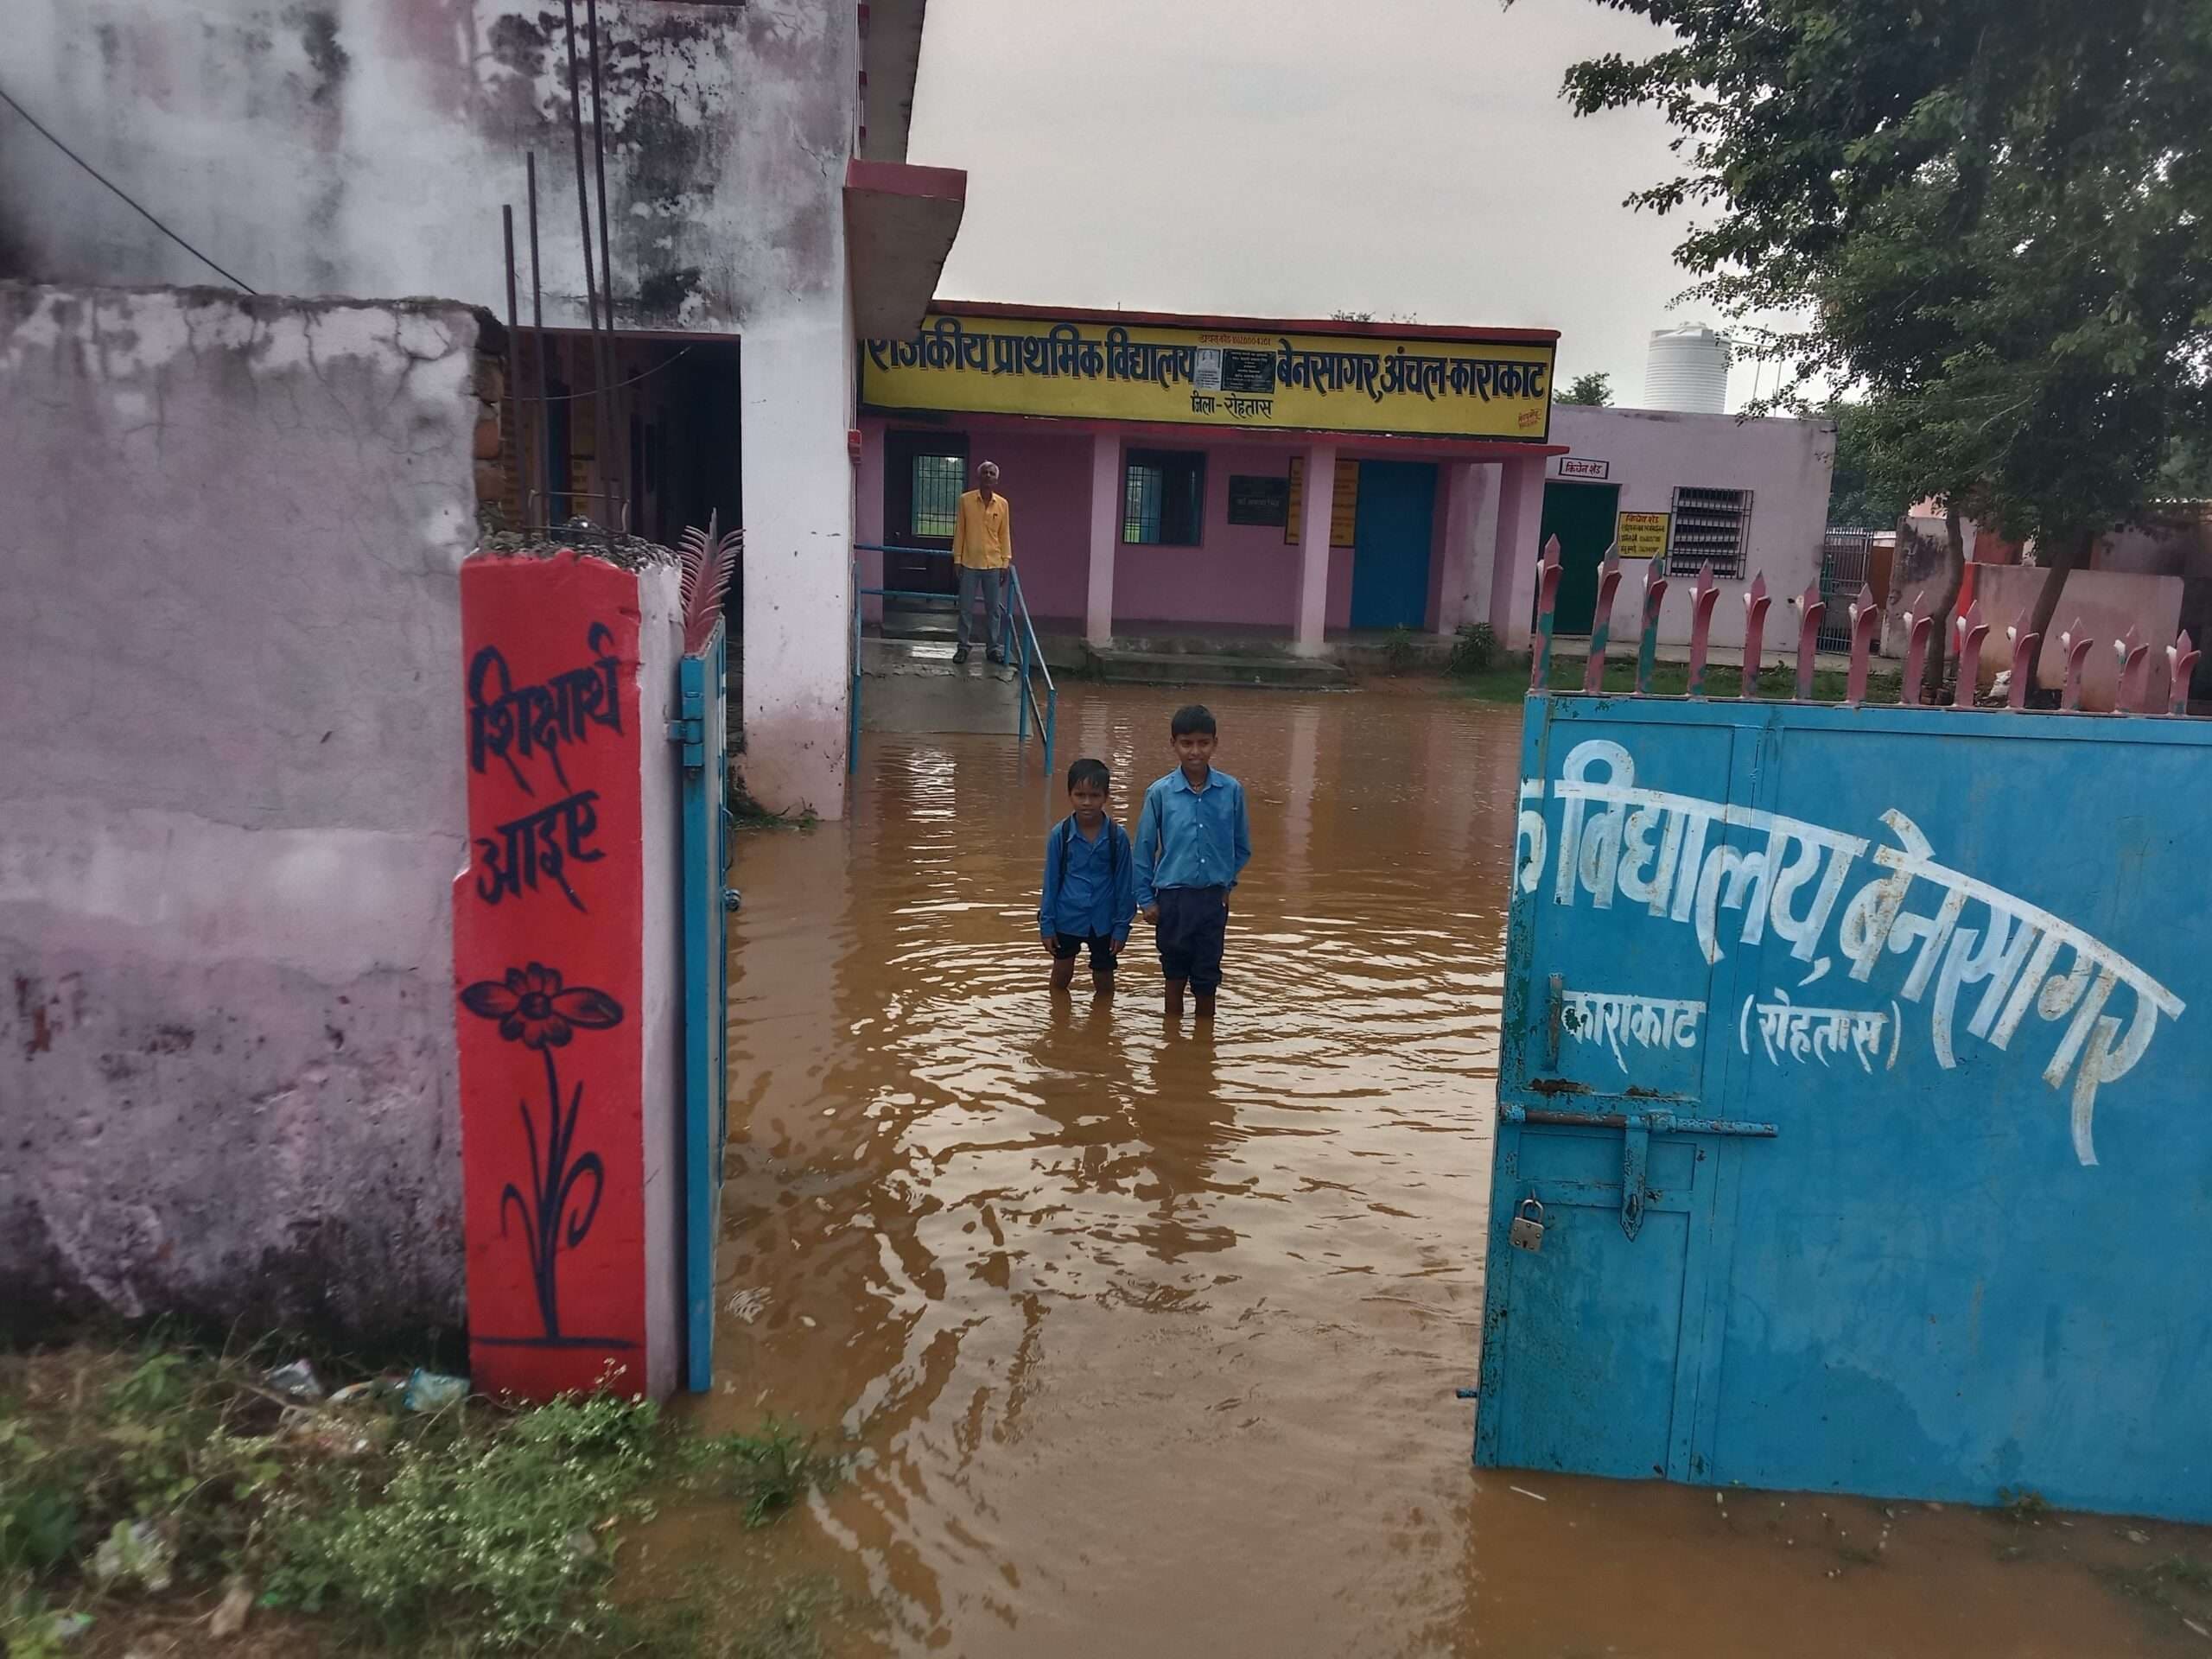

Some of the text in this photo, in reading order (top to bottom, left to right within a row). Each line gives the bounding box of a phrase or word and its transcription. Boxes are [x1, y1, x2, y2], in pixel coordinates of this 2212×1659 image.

[990, 322, 1104, 379] प्राथमिक
[1105, 325, 1198, 389] विद्यालय
[474, 789, 607, 914] आइए
[1560, 988, 1707, 1074] काराकाट
[1840, 808, 2187, 1166] बेनसागर
